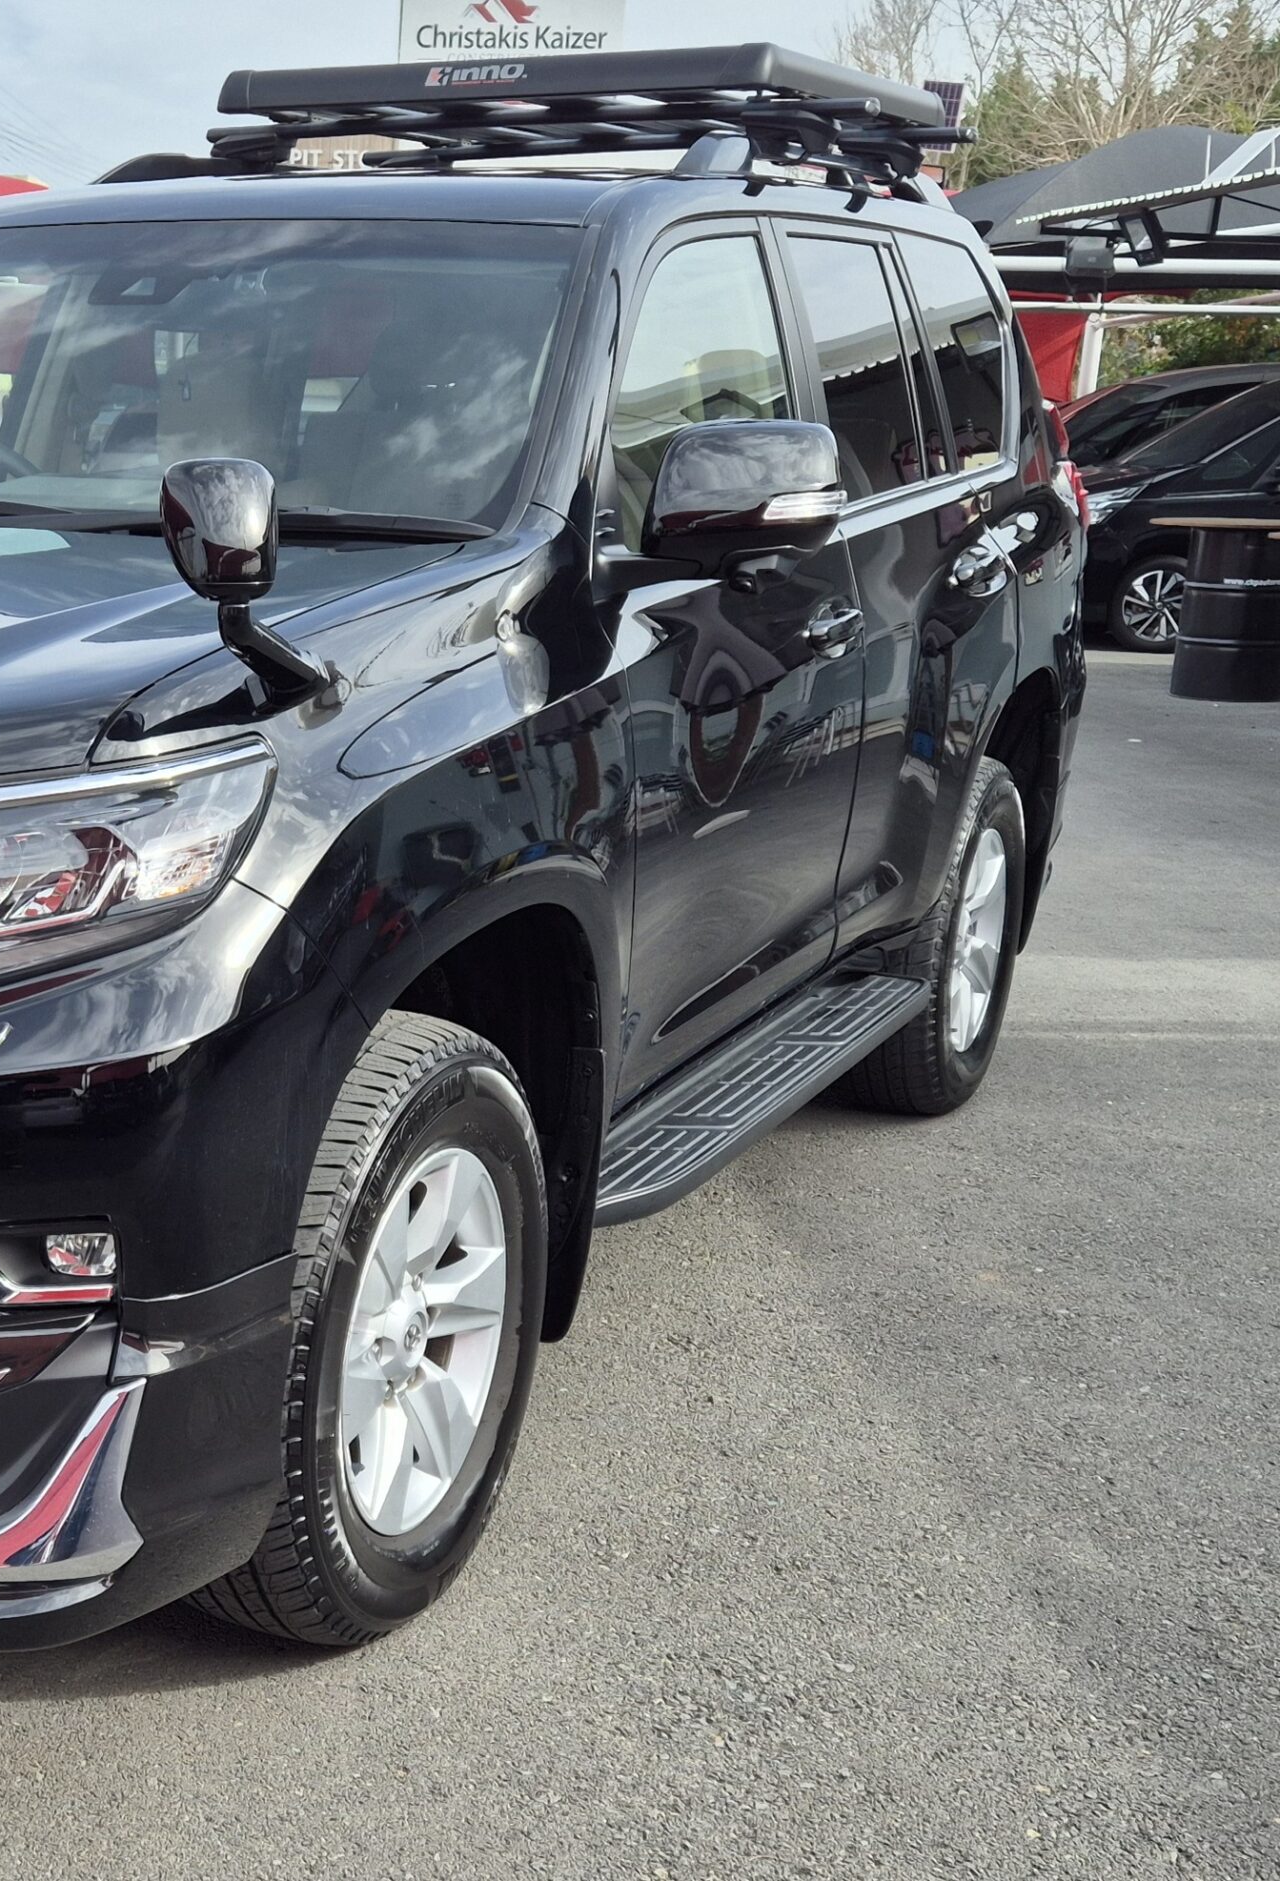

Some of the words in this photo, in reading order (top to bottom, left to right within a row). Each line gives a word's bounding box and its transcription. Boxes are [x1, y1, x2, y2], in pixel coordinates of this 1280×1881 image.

[416, 24, 529, 49] Christakis
[534, 25, 608, 49] Kaizer
[289, 147, 322, 167] PIT
